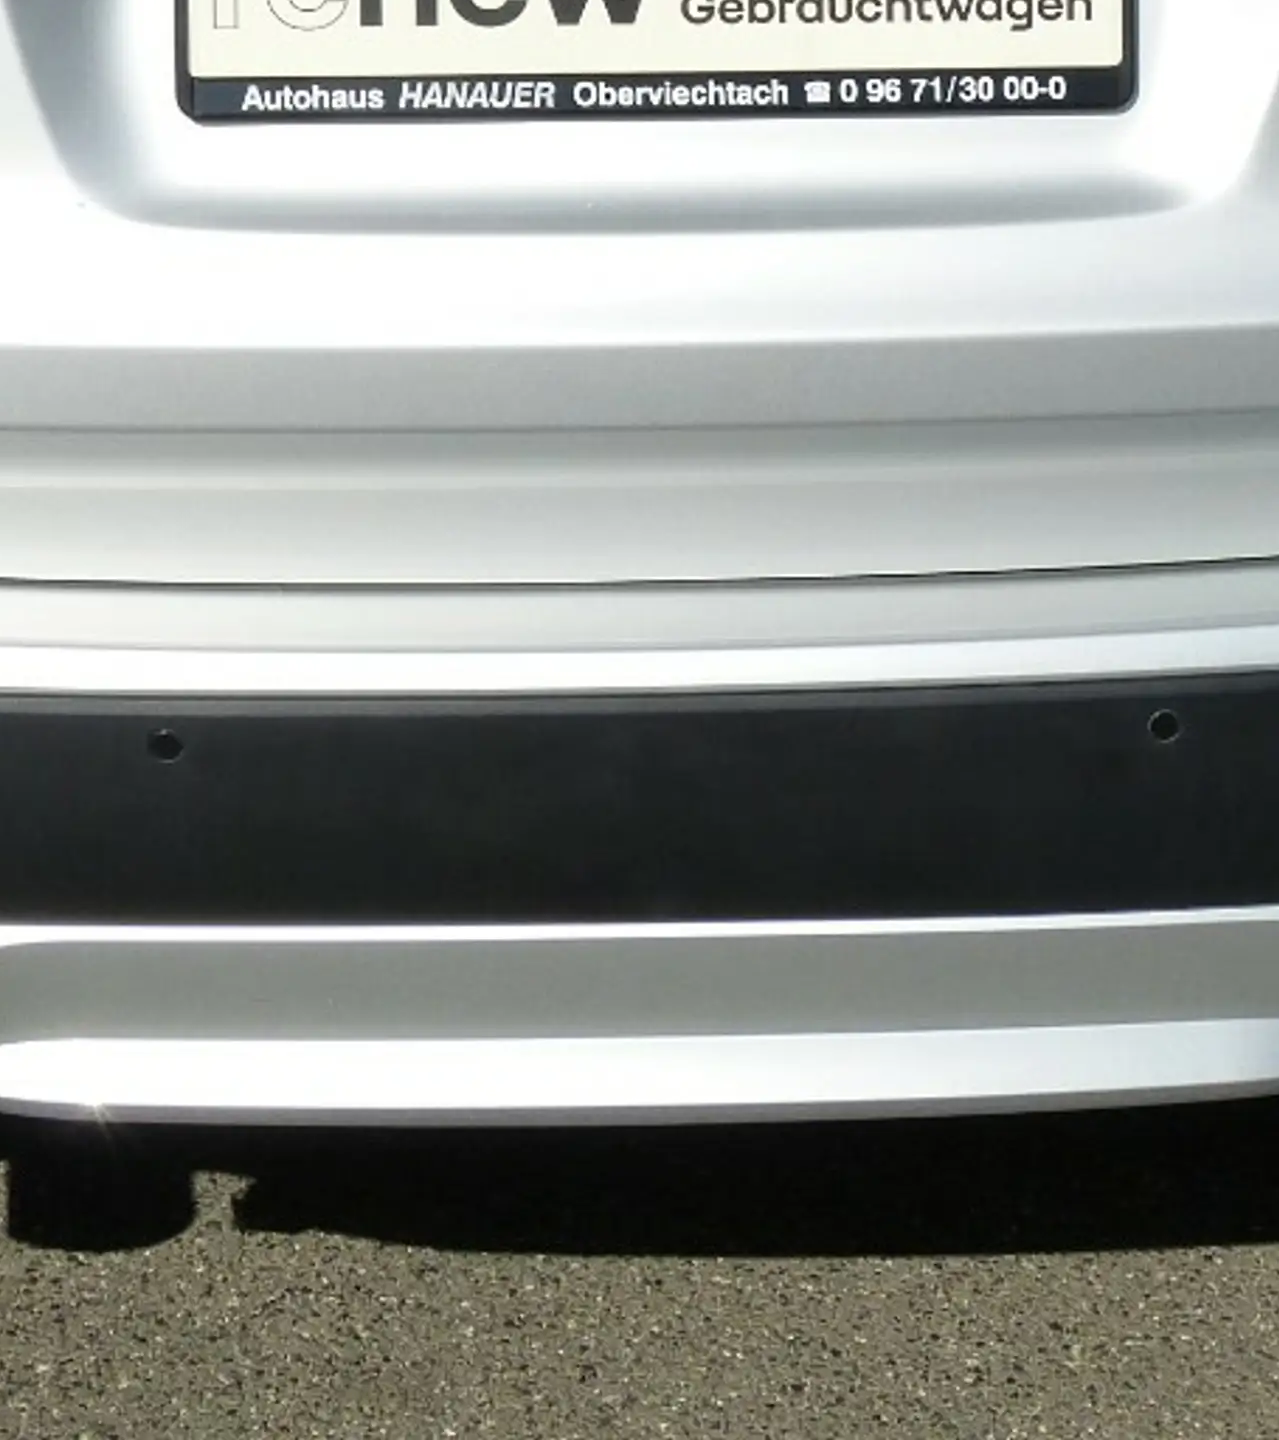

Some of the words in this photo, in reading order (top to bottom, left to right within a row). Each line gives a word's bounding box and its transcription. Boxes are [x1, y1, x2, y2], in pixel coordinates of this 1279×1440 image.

[241, 84, 385, 111] Autohaus
[398, 81, 556, 109] HANAUER
[572, 79, 789, 107] Oberviechtach
[839, 78, 858, 103] 0
[866, 77, 902, 103] 96
[909, 75, 993, 102] 71/30
[1003, 75, 1068, 101] 00-0
